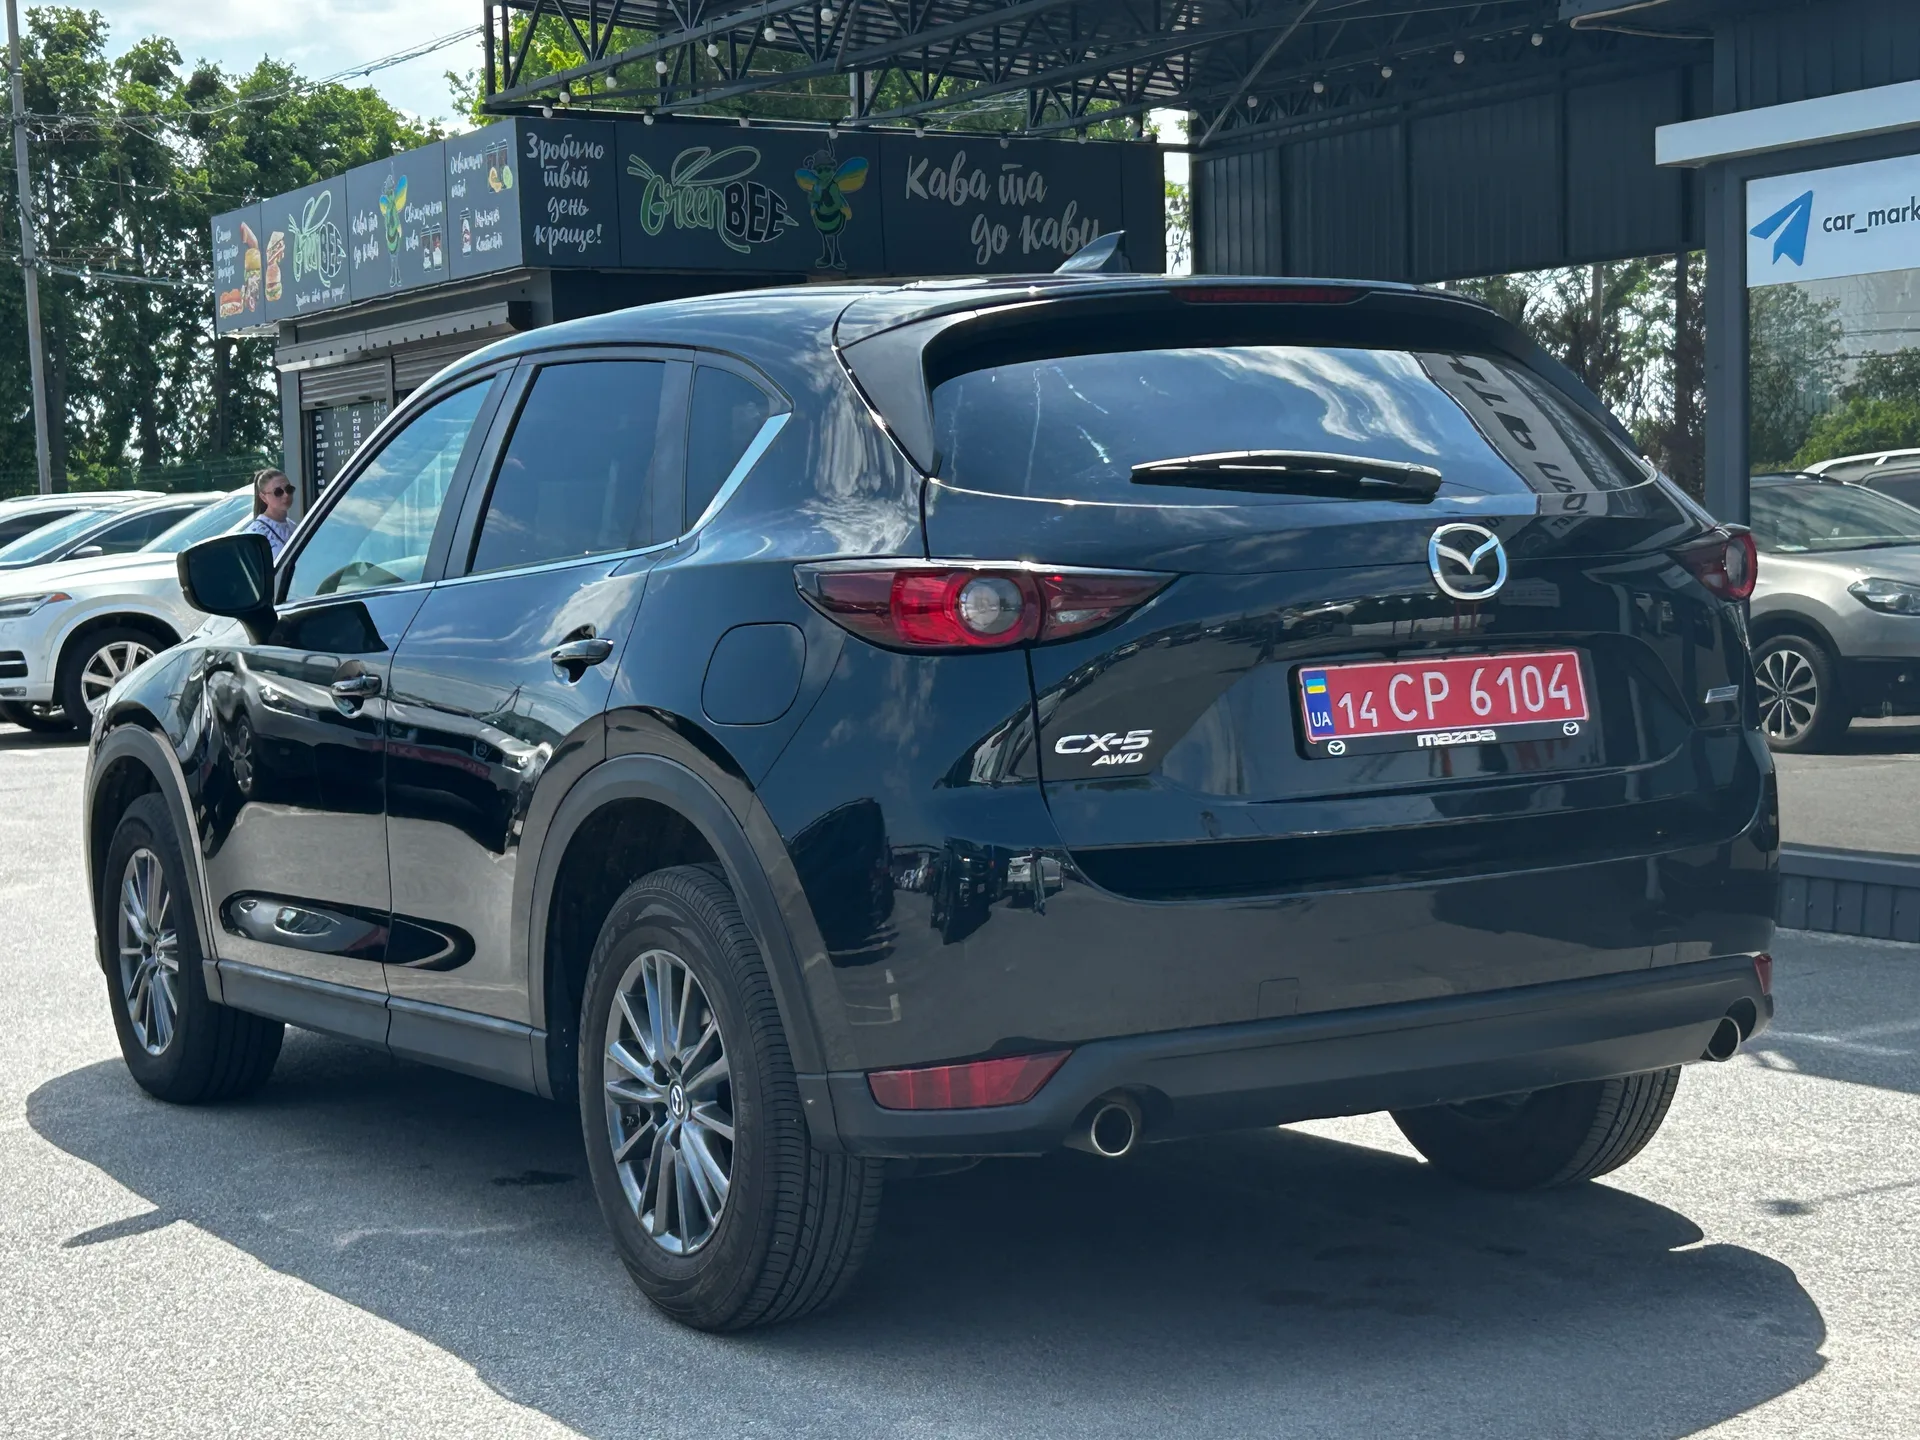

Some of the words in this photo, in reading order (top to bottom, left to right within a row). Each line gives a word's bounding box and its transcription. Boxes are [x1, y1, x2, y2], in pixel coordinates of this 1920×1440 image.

[526, 132, 604, 168] Зробимо
[544, 161, 590, 188] твій
[905, 150, 992, 206] Кава
[998, 163, 1049, 207] та
[547, 195, 590, 223] день
[533, 223, 603, 255] краще!
[970, 213, 1010, 266] до
[1018, 200, 1099, 255] кави
[1311, 711, 1332, 728] UA
[1337, 691, 1379, 729] 14
[1388, 671, 1450, 722] CP
[1470, 663, 1572, 717] 6104
[1054, 729, 1153, 754] CX-5
[1091, 752, 1144, 767] AWD
